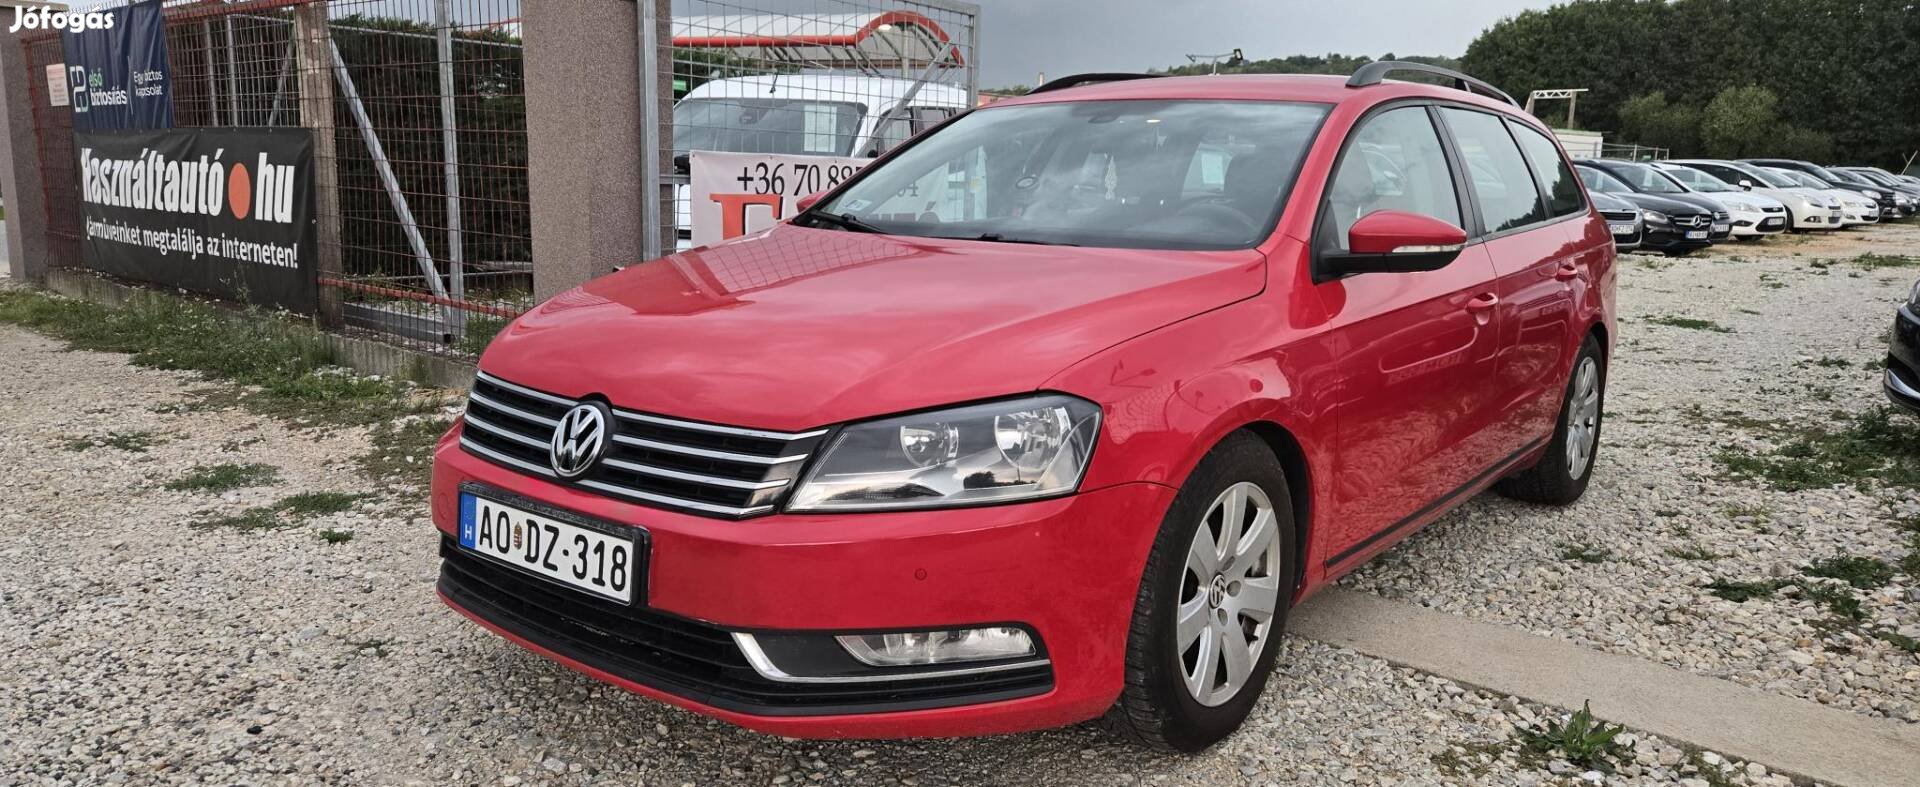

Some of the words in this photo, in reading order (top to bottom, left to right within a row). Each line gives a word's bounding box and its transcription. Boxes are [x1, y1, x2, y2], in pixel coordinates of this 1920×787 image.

[737, 162, 785, 195] +36
[793, 164, 820, 196] 70
[143, 227, 203, 260] megtalálja
[207, 237, 220, 256] az
[221, 233, 298, 269] interneten!
